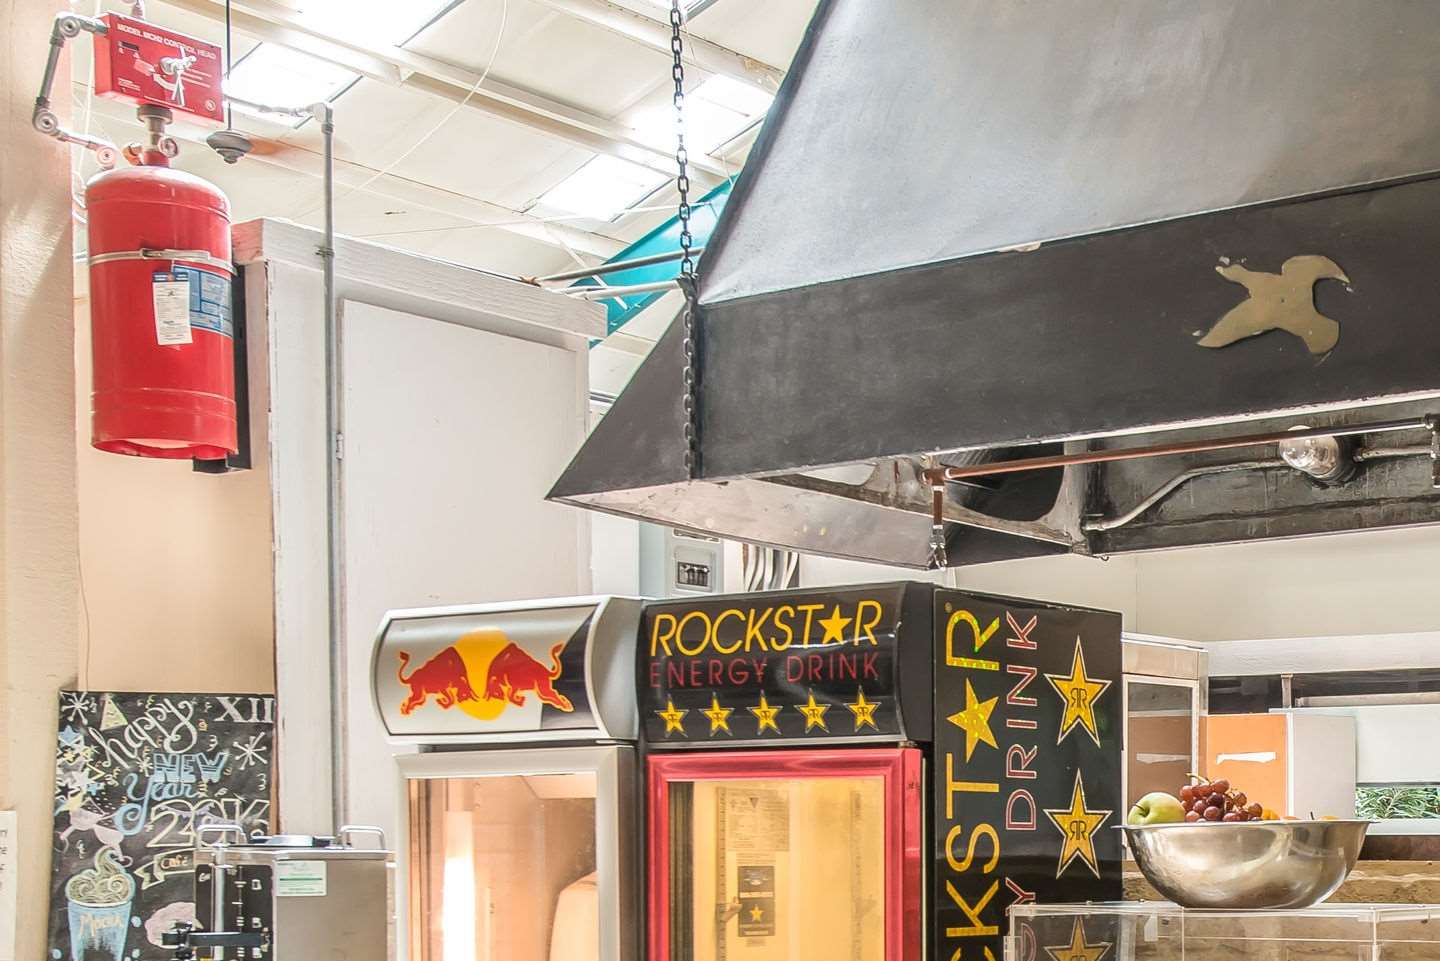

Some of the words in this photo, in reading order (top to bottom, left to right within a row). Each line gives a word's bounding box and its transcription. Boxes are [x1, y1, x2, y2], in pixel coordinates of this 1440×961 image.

[649, 655, 768, 689] ENERGY
[785, 650, 880, 684] DRINK
[1005, 610, 1039, 833] DRINK
[152, 751, 229, 783] NEW
